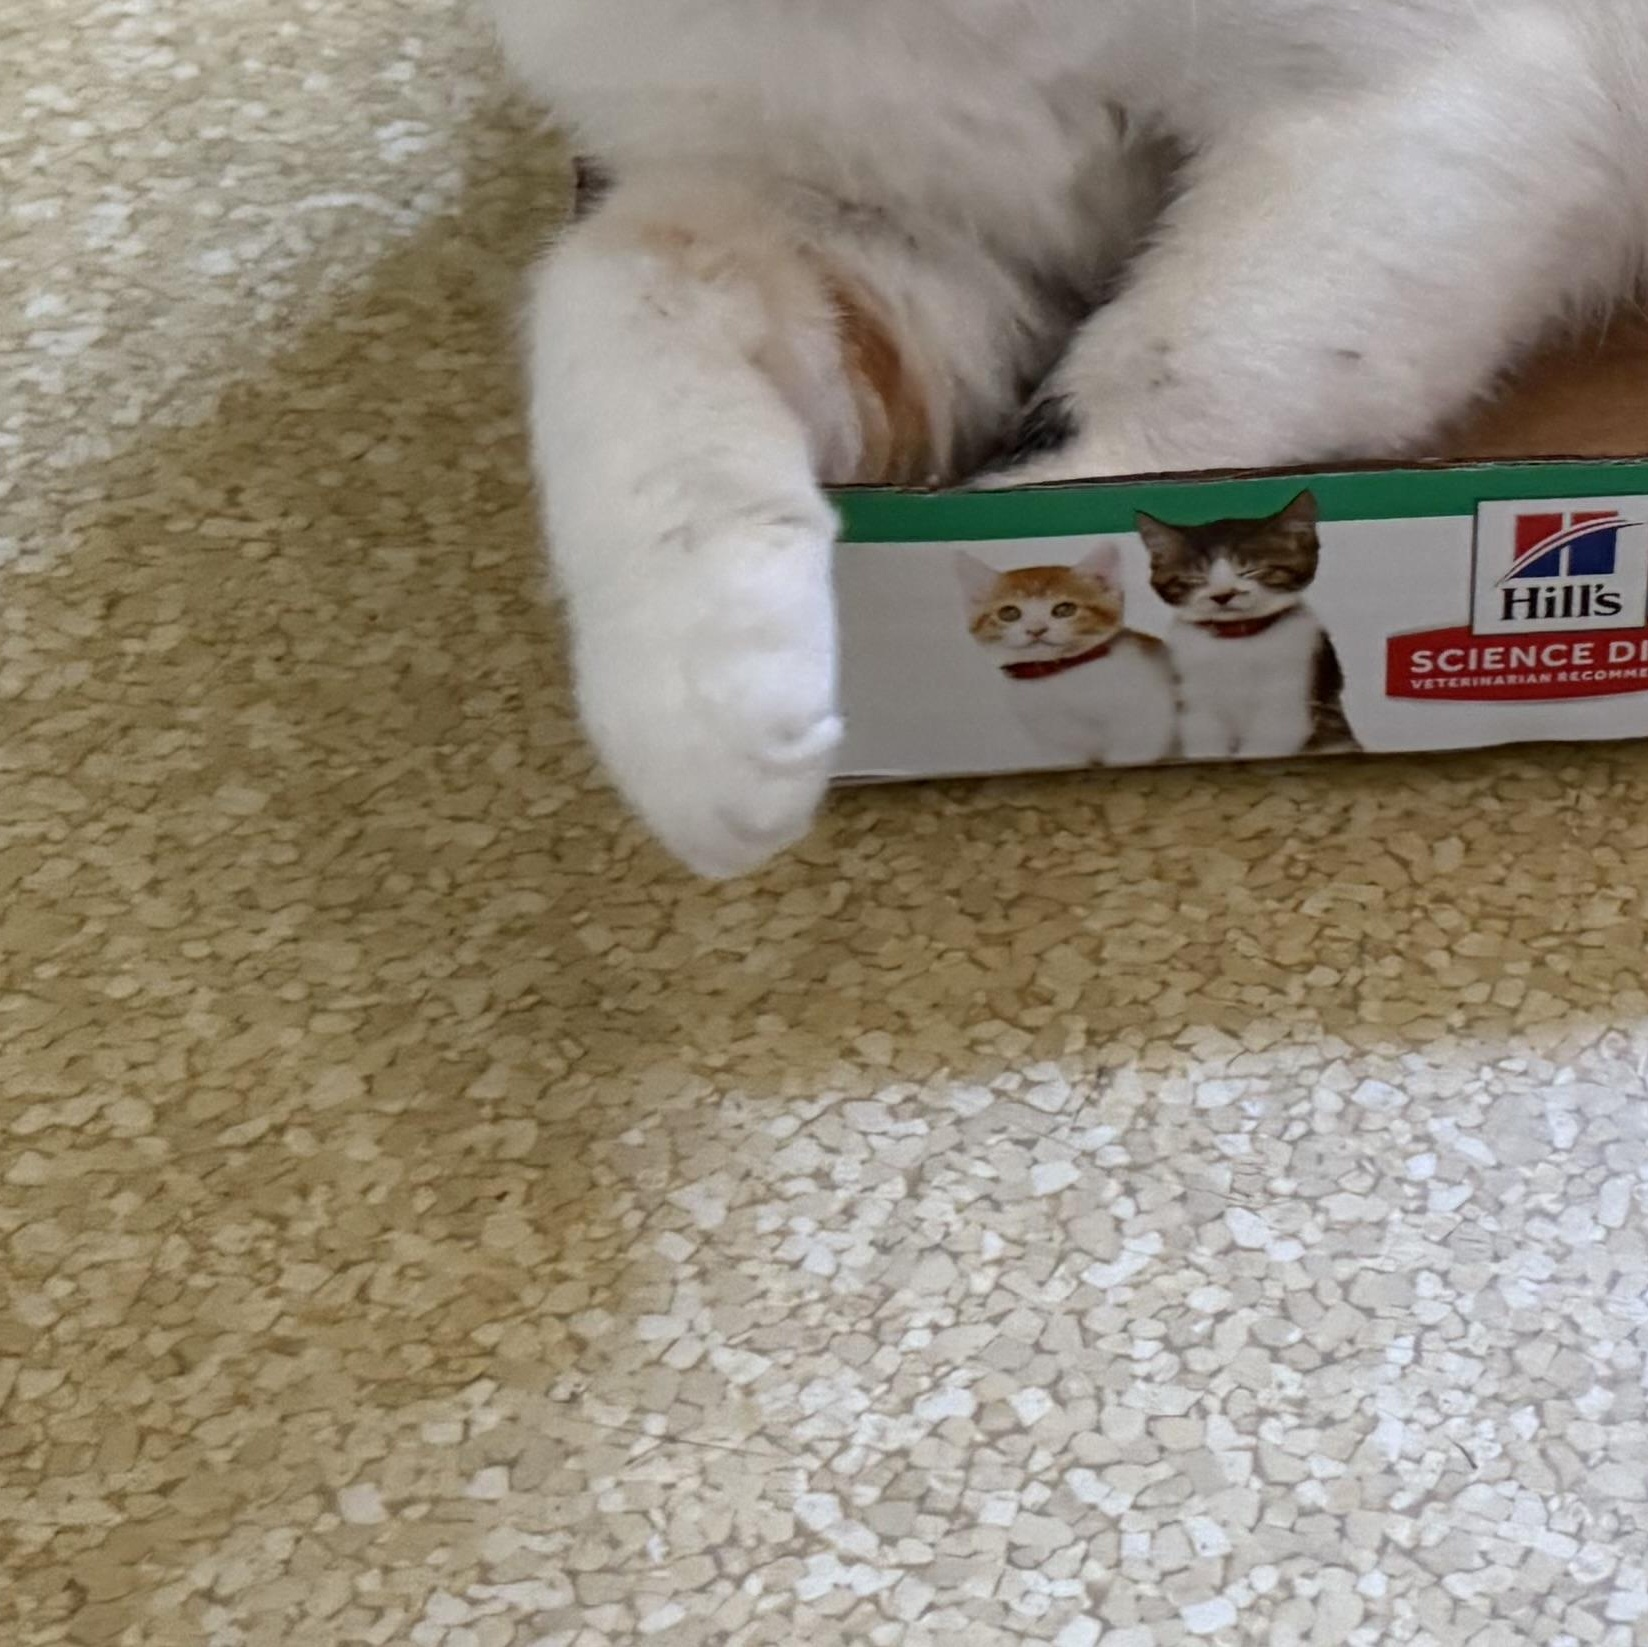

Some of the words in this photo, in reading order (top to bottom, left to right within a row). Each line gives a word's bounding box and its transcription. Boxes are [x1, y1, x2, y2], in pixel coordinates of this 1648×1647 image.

[1500, 583, 1622, 620] Hill's
[1409, 642, 1595, 674] SCIENCE
[1410, 671, 1552, 690] VETERINARIAN
